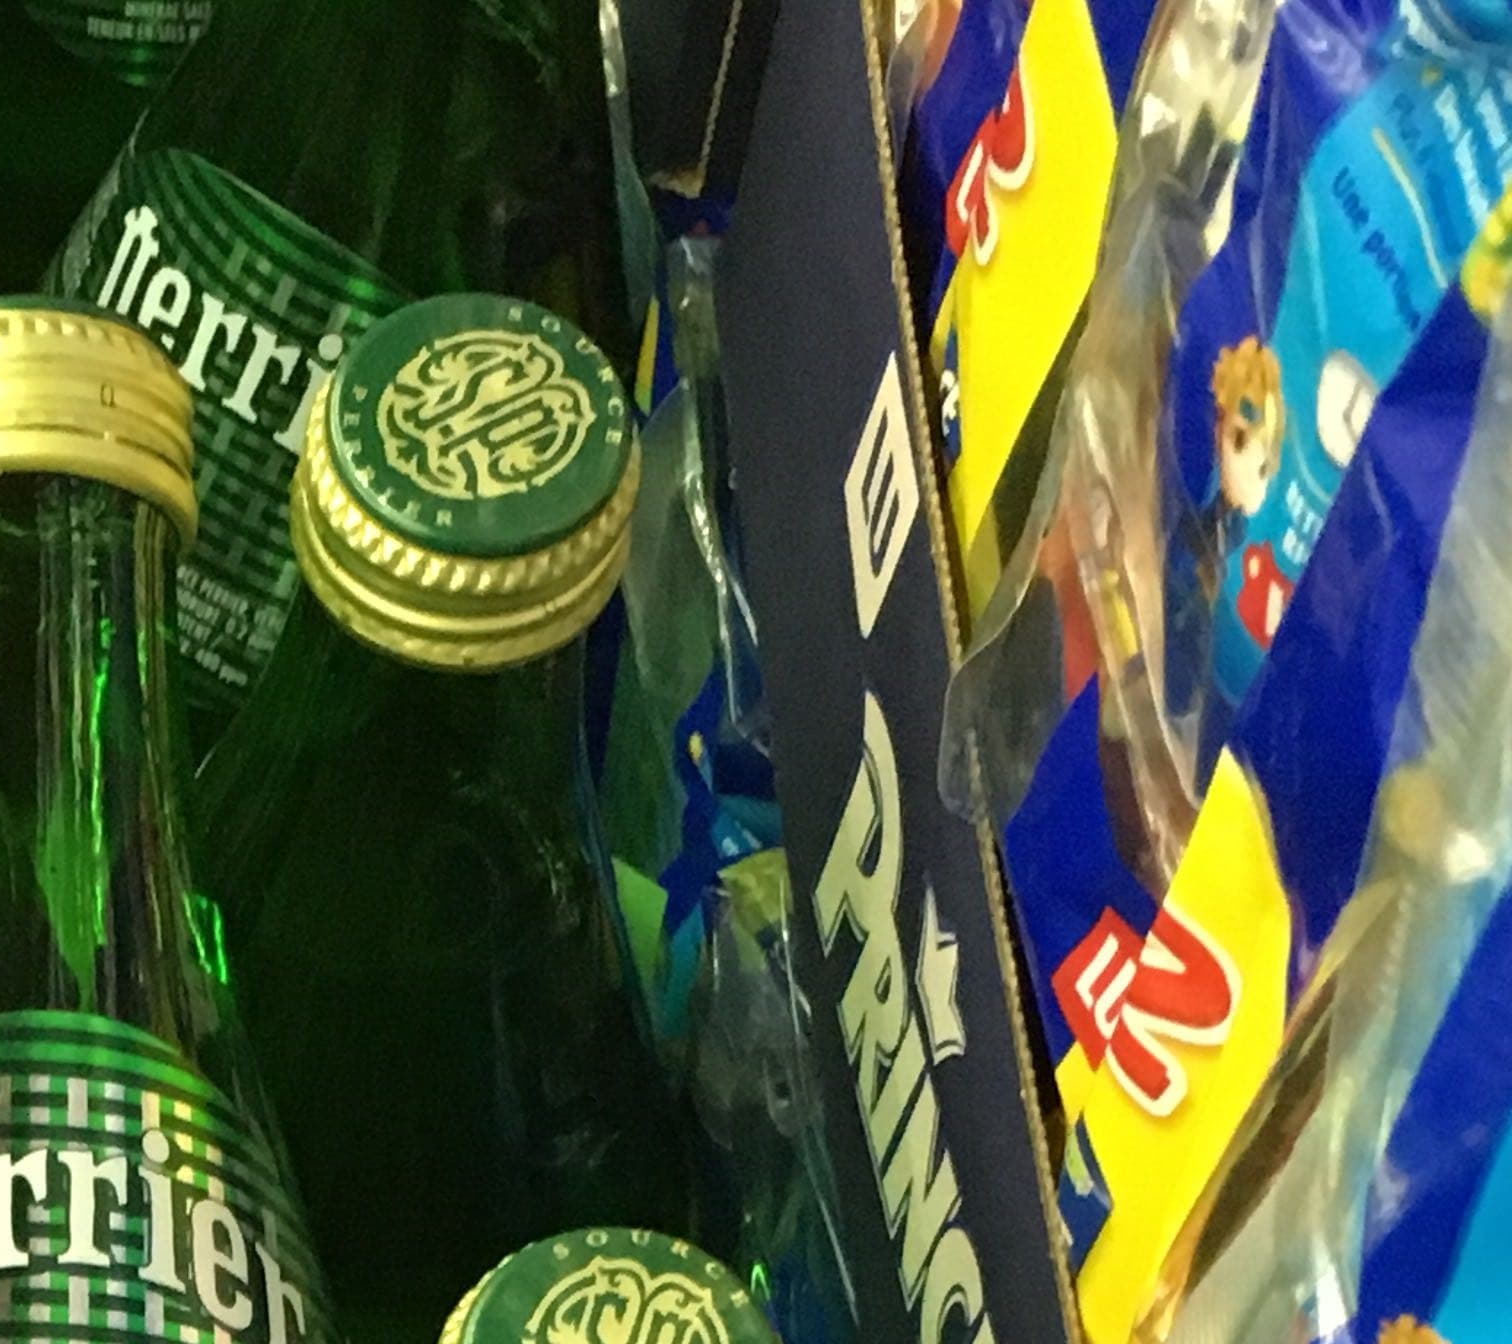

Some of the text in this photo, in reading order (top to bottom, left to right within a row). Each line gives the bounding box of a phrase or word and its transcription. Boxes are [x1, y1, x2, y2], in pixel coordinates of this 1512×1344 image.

[508, 305, 624, 450] SOURCE
[344, 382, 455, 529] PERRIER
[552, 1229, 751, 1309] SOURCE
